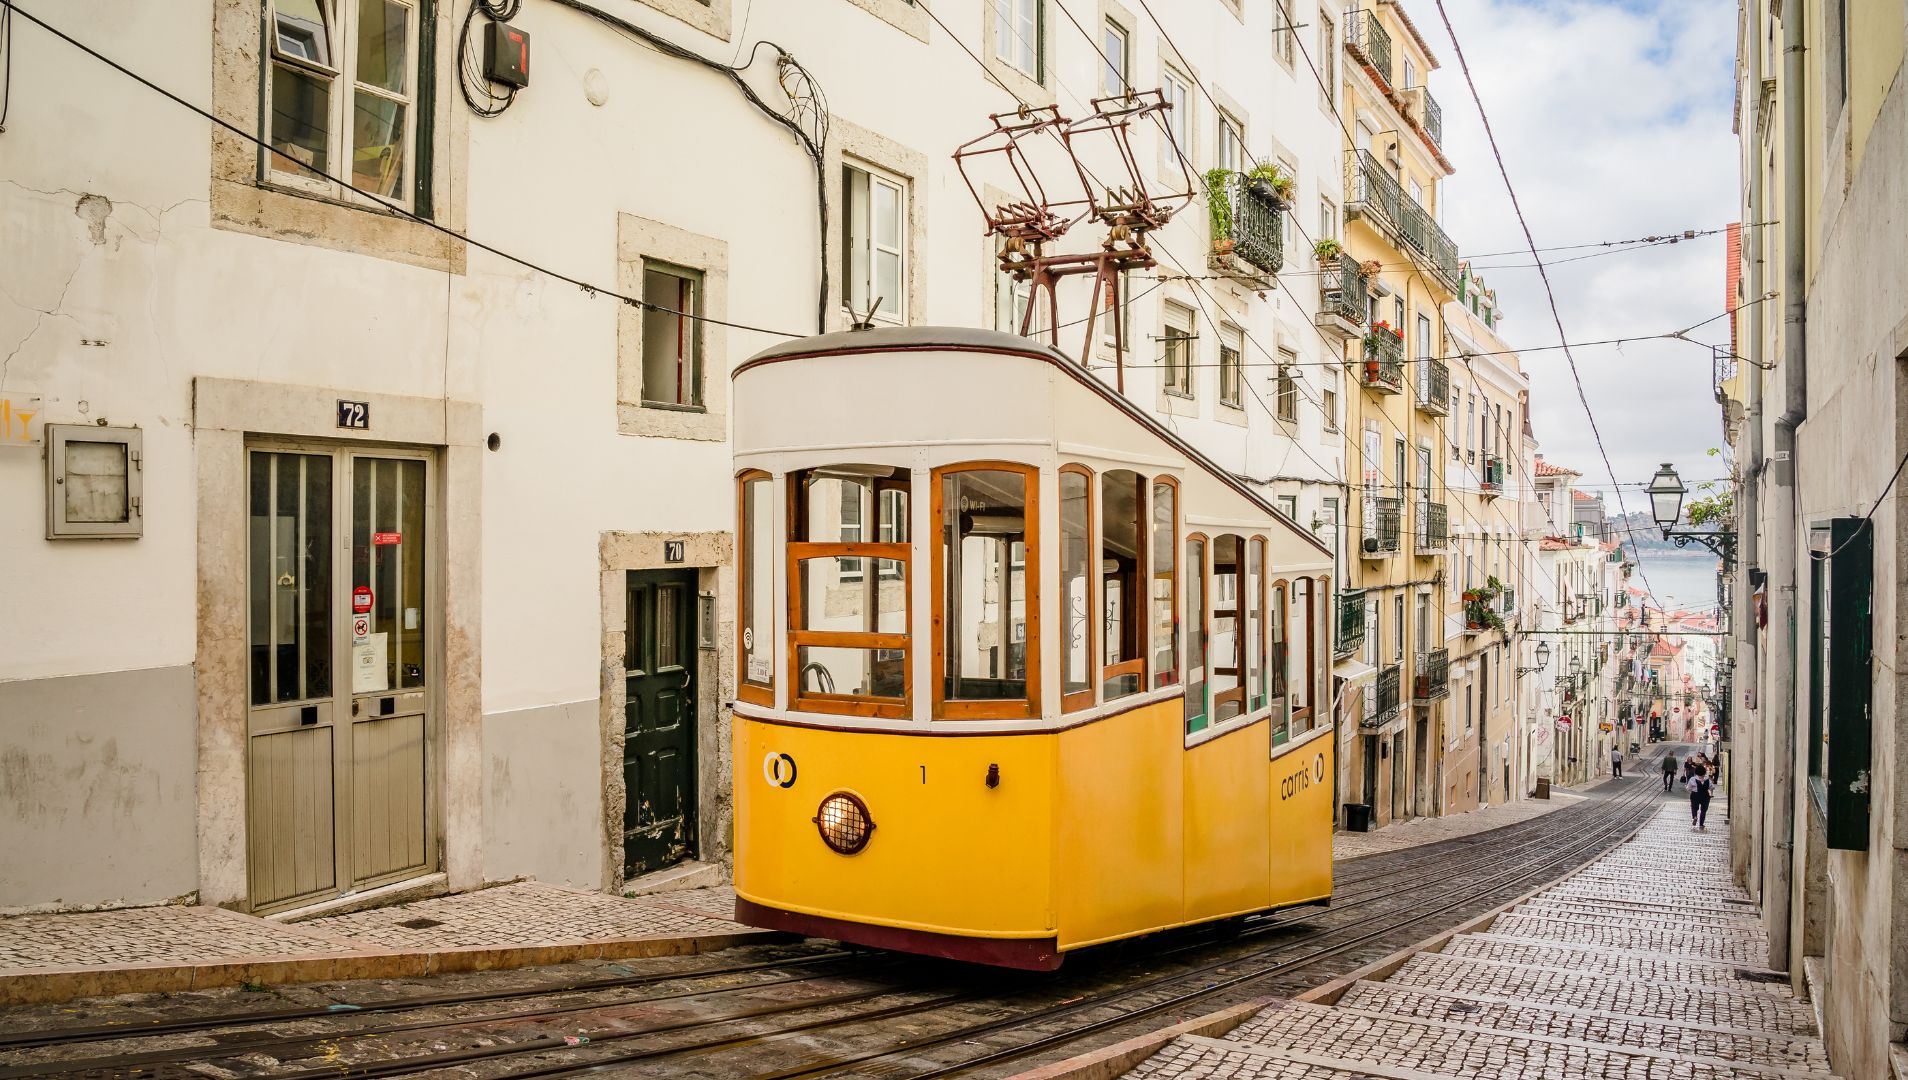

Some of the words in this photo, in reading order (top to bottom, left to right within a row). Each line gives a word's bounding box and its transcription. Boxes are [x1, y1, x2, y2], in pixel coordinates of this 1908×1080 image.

[343, 403, 364, 427] 72
[669, 542, 682, 561] 70
[919, 765, 926, 785] 1
[1281, 760, 1309, 801] carris
